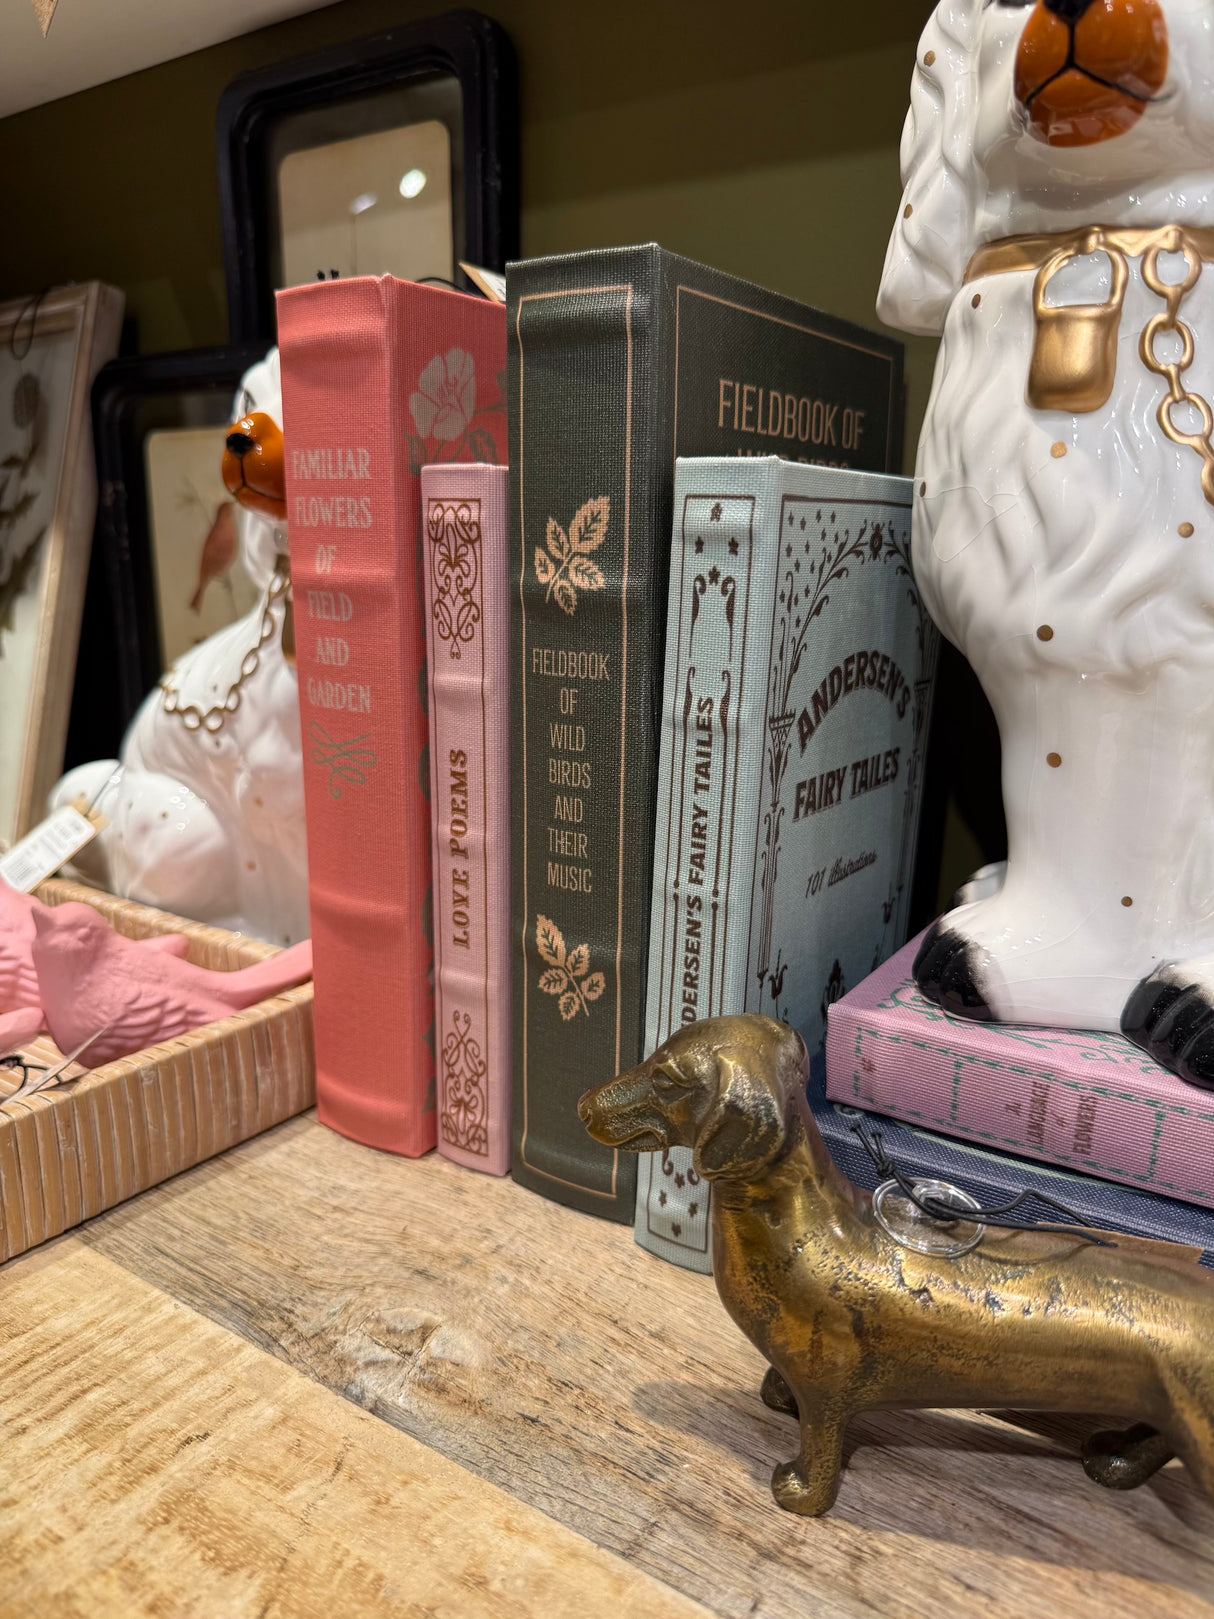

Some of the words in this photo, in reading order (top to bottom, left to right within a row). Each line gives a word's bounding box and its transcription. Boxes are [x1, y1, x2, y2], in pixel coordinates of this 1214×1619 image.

[718, 378, 840, 447] FIELDBOOK
[841, 407, 866, 450] OF
[291, 447, 372, 480] FAMILIAR
[294, 496, 372, 529] FLOWERS
[315, 545, 336, 575] OF
[307, 590, 353, 621] FIELD
[315, 638, 349, 666] AND
[532, 647, 610, 681] FIELDBOOK
[307, 678, 372, 713] GARDEN
[560, 687, 578, 714] OF
[797, 650, 911, 757] ANDERSEN'S
[549, 722, 585, 751] WILD
[693, 696, 713, 794] TAILES
[548, 758, 591, 789] BIRDS
[793, 766, 848, 821] FAIRY
[850, 747, 901, 799] TAILES
[450, 749, 469, 859] POEMS
[553, 795, 583, 823] AND
[547, 827, 588, 859] THEIR
[688, 802, 708, 885] FAIRY
[547, 861, 592, 893] MUSIC
[806, 867, 826, 898] 101
[452, 868, 470, 950] LOVE
[681, 894, 704, 1028] DERSEN'S
[1072, 1094, 1098, 1156] FLOWERS
